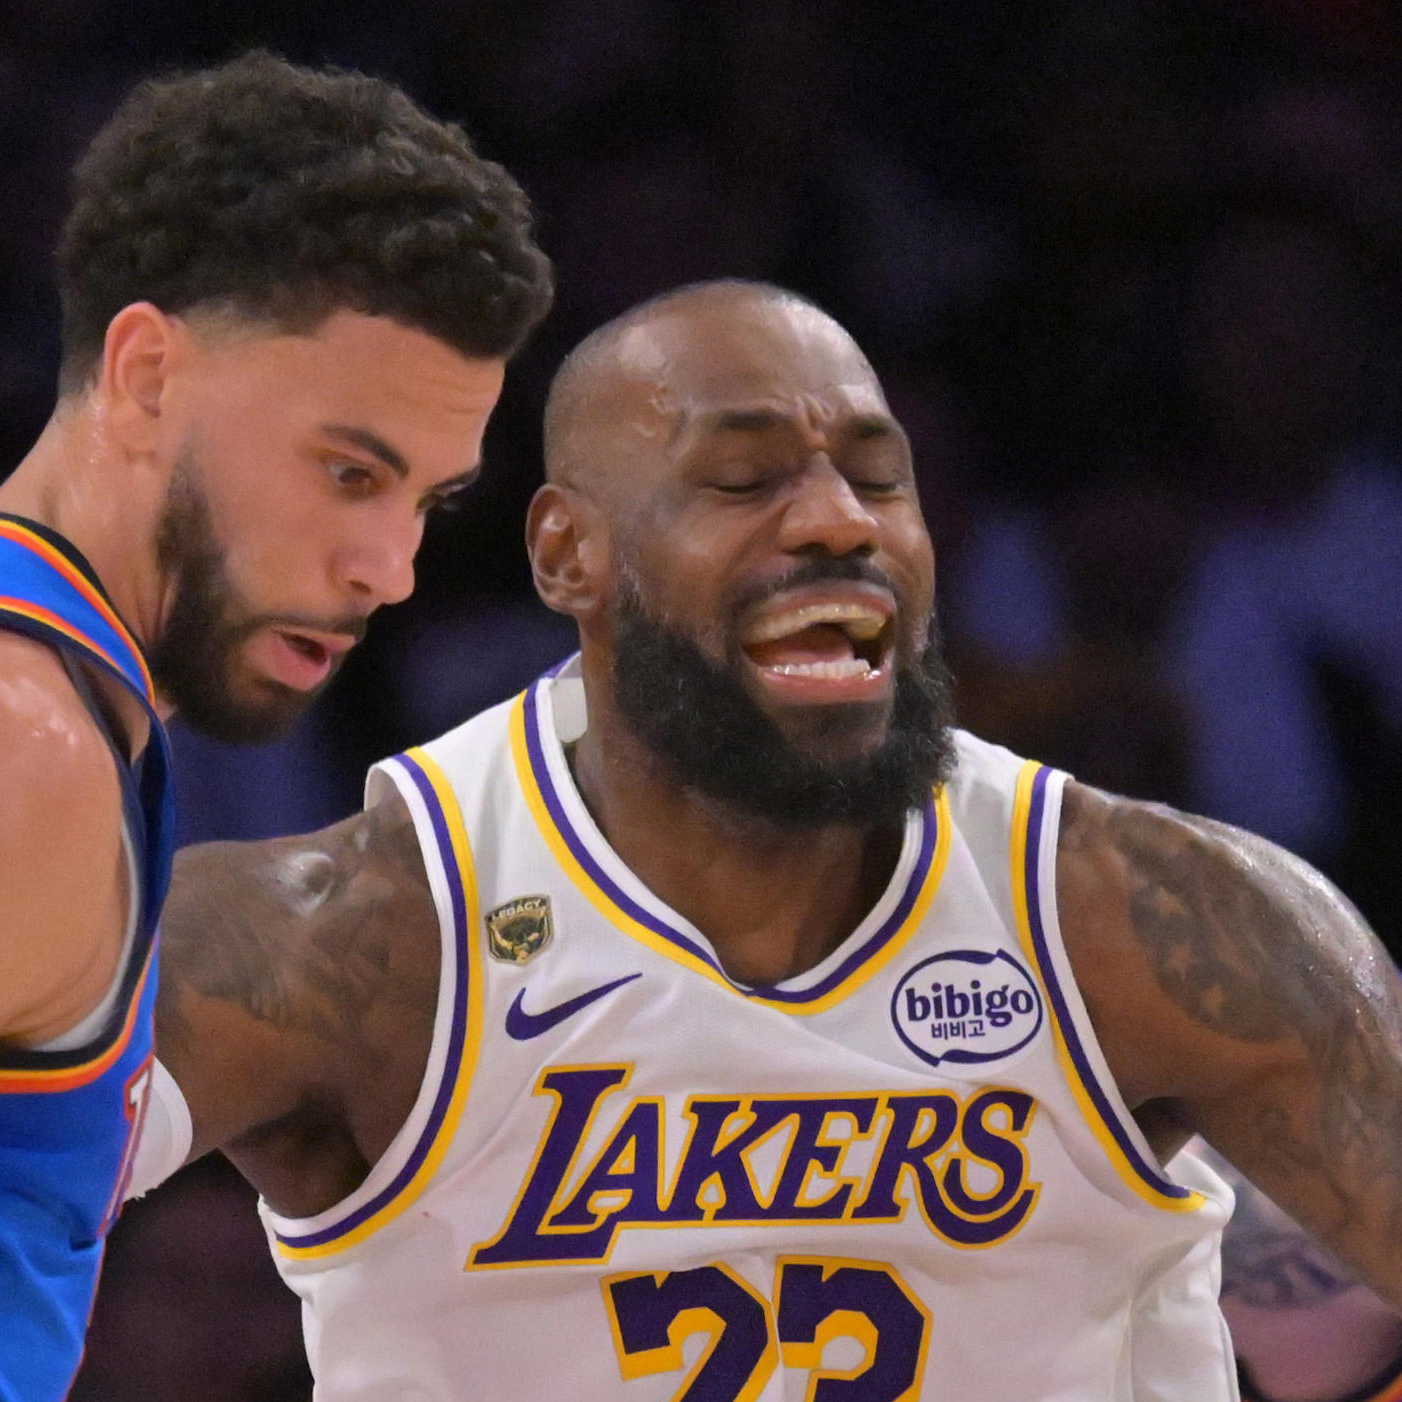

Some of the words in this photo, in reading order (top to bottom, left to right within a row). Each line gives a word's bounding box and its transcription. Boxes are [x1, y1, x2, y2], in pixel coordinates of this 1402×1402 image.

[491, 898, 541, 921] LEGACY
[905, 979, 1034, 1028] bibigo
[931, 1019, 986, 1040] 비비고
[464, 1062, 1042, 1271] LAKERS
